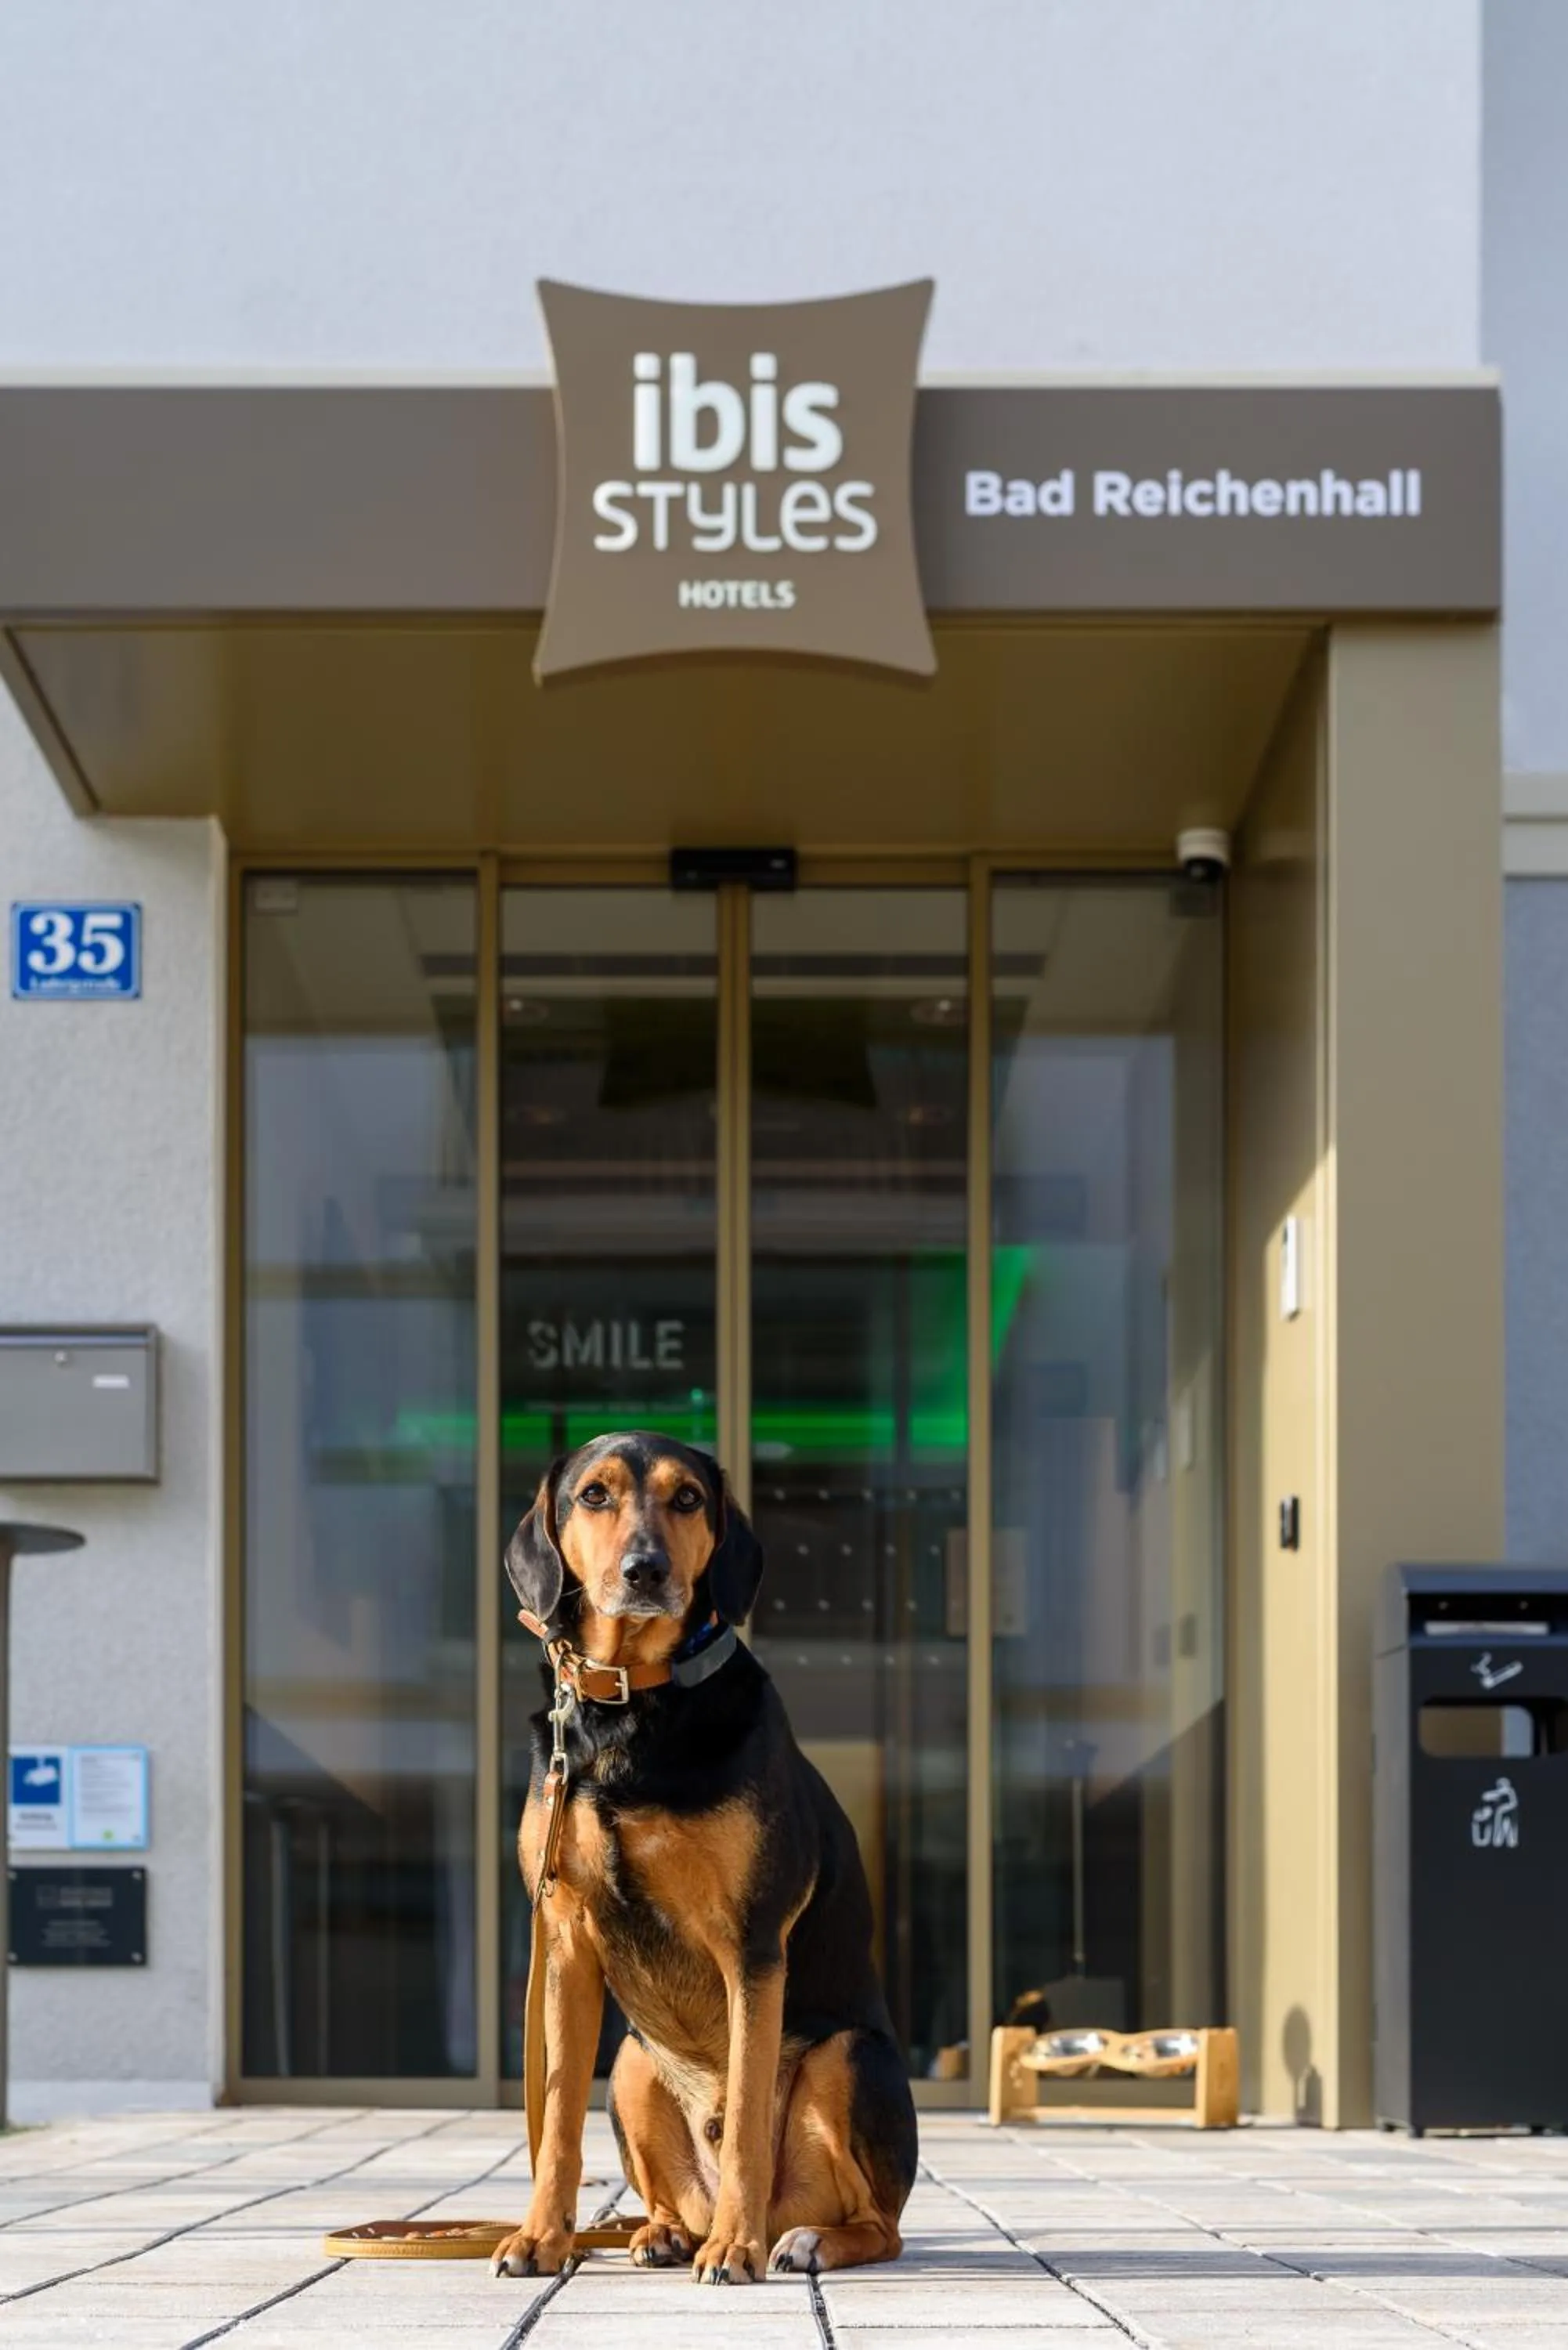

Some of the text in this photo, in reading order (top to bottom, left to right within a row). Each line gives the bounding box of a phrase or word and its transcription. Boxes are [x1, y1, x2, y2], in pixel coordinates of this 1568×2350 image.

[633, 352, 844, 472] ibis
[965, 469, 1422, 517] Bad Reichenhall
[678, 581, 796, 609] HOTELS
[27, 912, 125, 974] 35
[528, 1319, 685, 1371] SMILE
